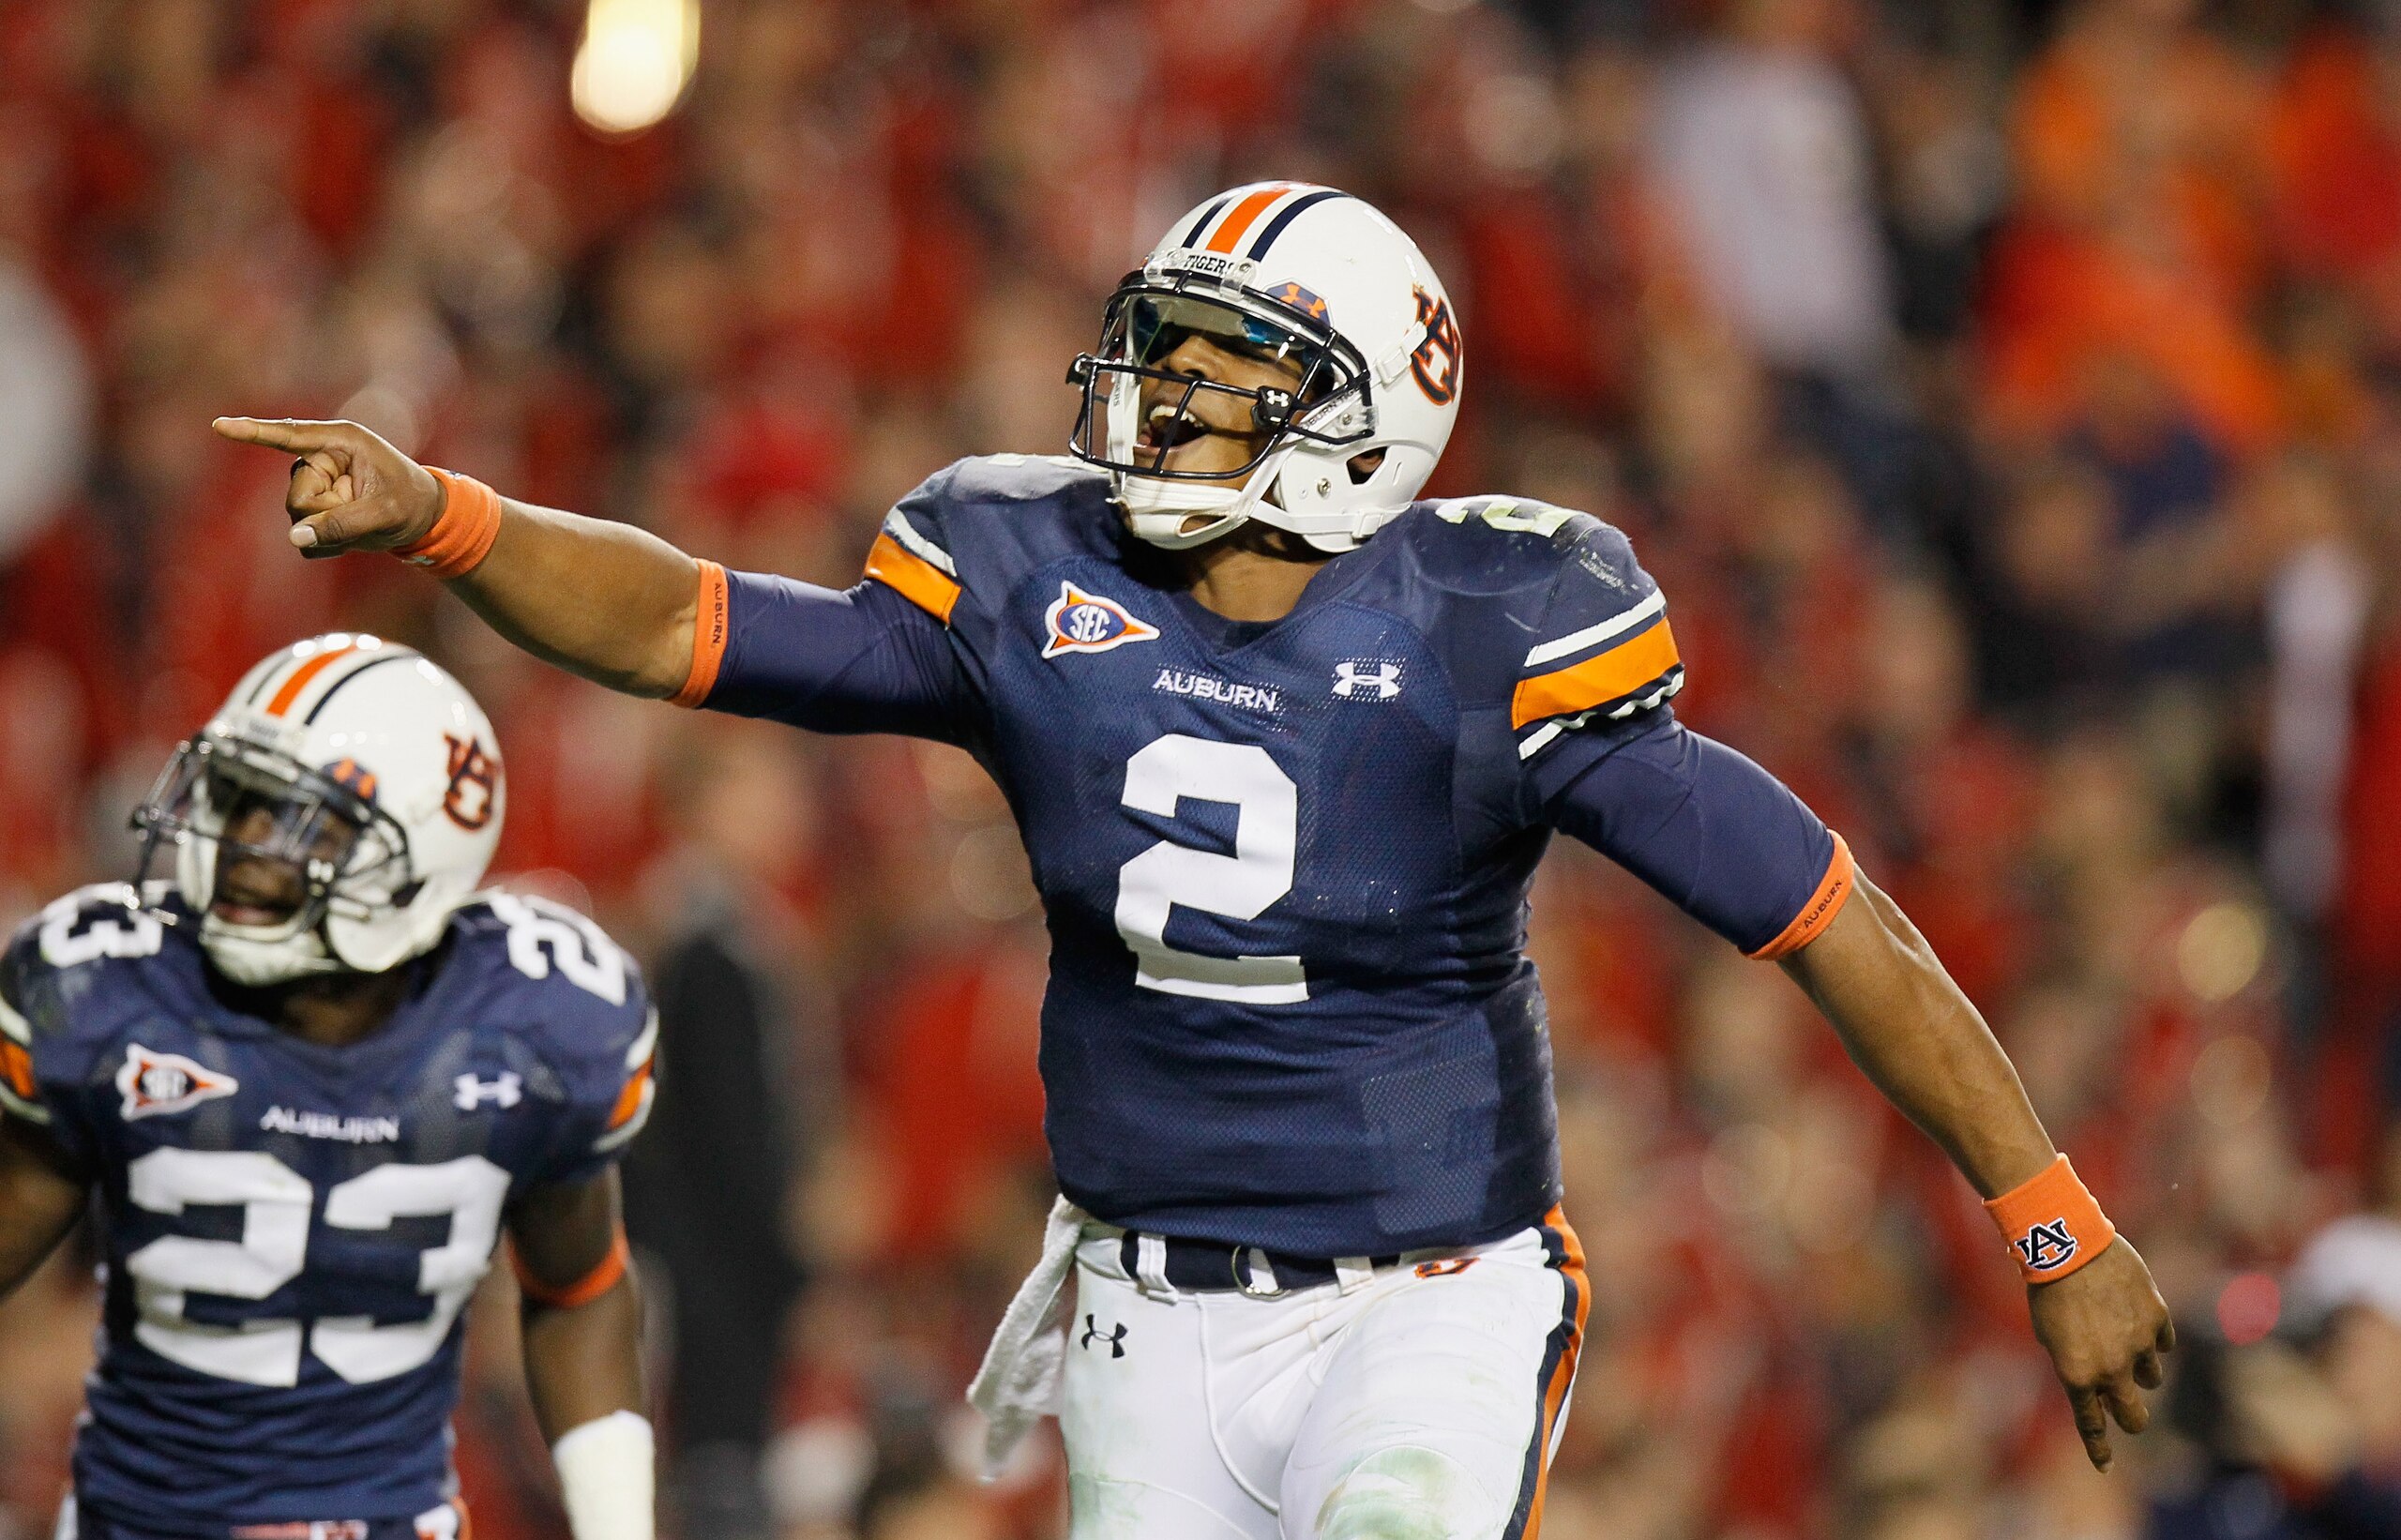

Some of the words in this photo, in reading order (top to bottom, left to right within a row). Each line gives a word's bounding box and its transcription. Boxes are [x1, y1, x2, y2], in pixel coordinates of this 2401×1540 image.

[1300, 400, 1336, 430] UBURN
[712, 582, 723, 644] AUBURN
[1069, 603, 1110, 642] SEC
[1152, 669, 1278, 712] AUBURN
[1114, 732, 1310, 1005] 2
[1804, 879, 1842, 929] AUBURN
[126, 1145, 512, 1389] 23
[2014, 1216, 2078, 1272] AU
